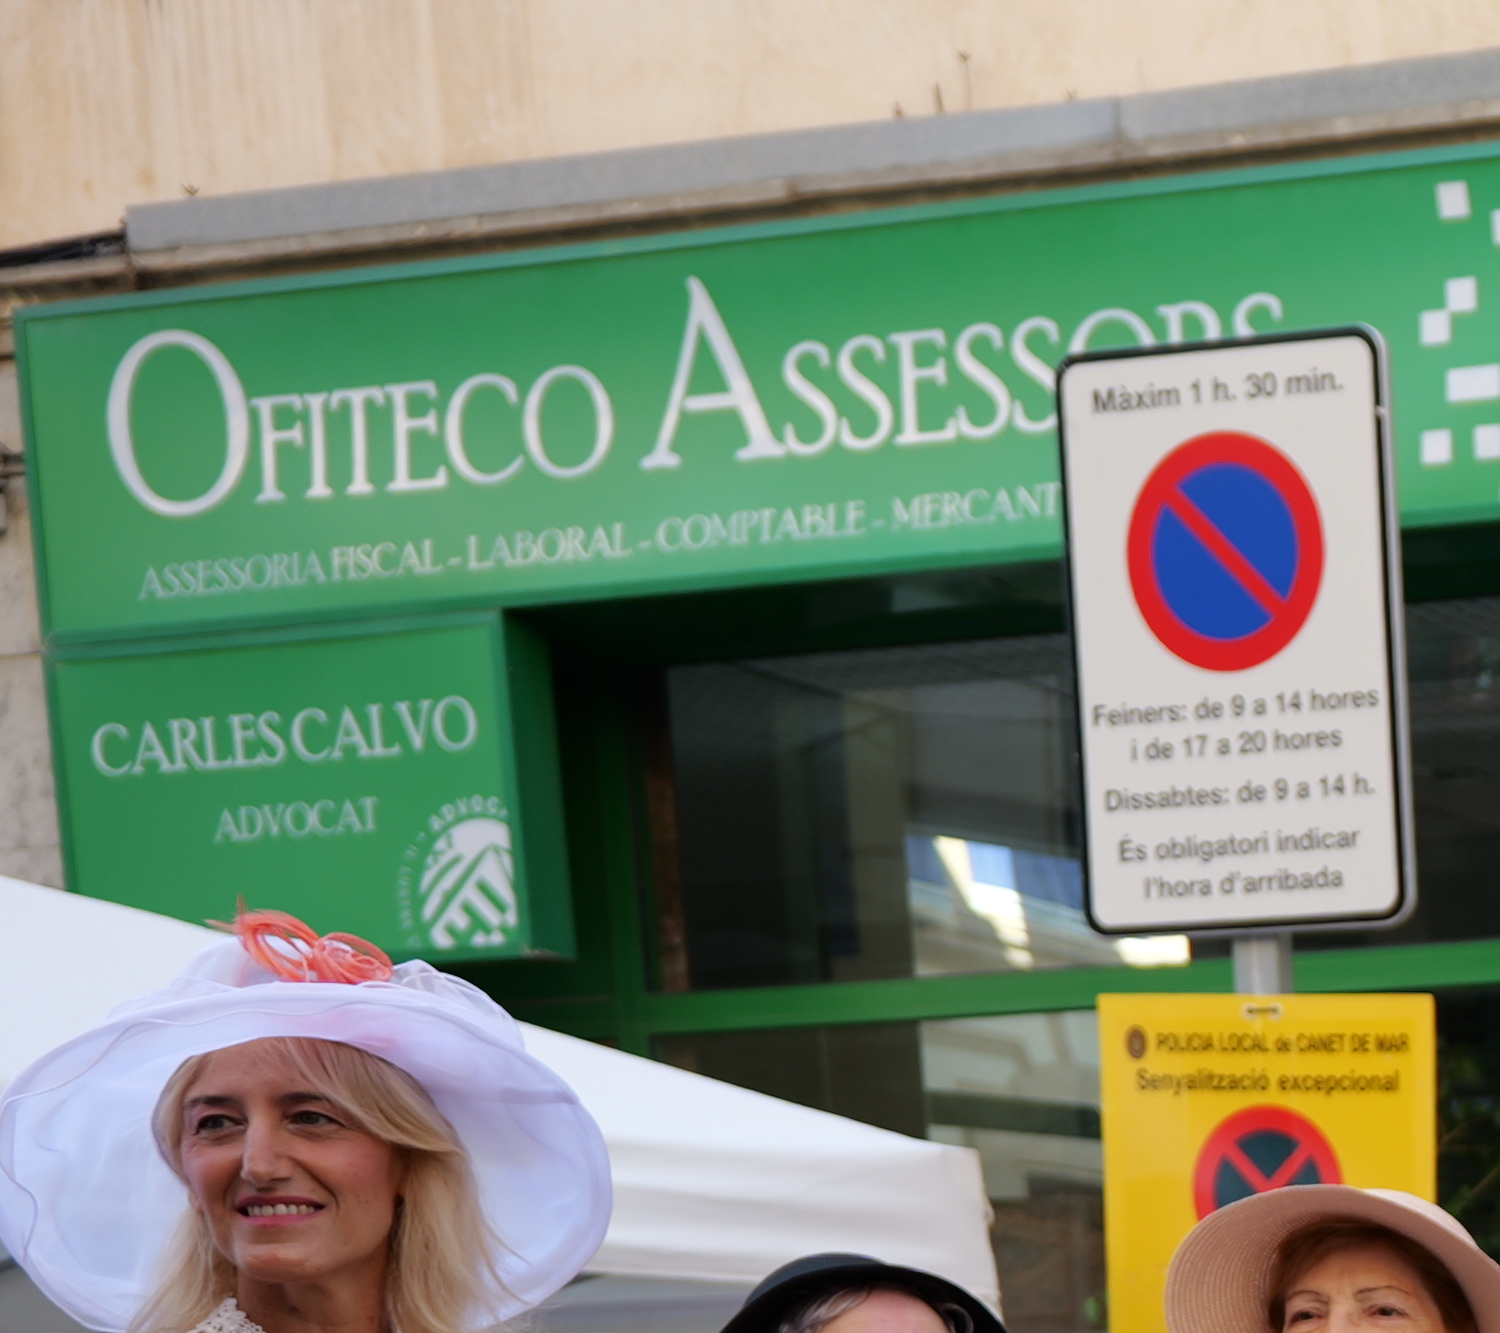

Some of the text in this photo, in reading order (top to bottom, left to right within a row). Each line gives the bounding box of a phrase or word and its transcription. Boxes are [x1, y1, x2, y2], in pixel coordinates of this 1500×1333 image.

[1091, 368, 1345, 414] Màxim 1 h. 30 min.
[107, 329, 614, 517] OFITECO
[138, 551, 328, 600] ASSESSORIA
[331, 539, 442, 581] FISCAL
[467, 523, 632, 570] LABORAL
[656, 499, 867, 552] COMPTABLE
[1091, 687, 1380, 727] Feiners: de 9 a 14 hores
[91, 693, 478, 777] CARLES CALVO
[1129, 728, 1344, 762] i de 17 a 20 hores
[1103, 771, 1376, 814] Dissabtes: de 9 a 14 h.
[213, 796, 379, 844] ADVOCAT
[1117, 826, 1361, 864] És obligatori indicar
[1143, 866, 1345, 900] l'hora d'arribada
[1136, 1067, 1401, 1097] Senyalització excepcional
